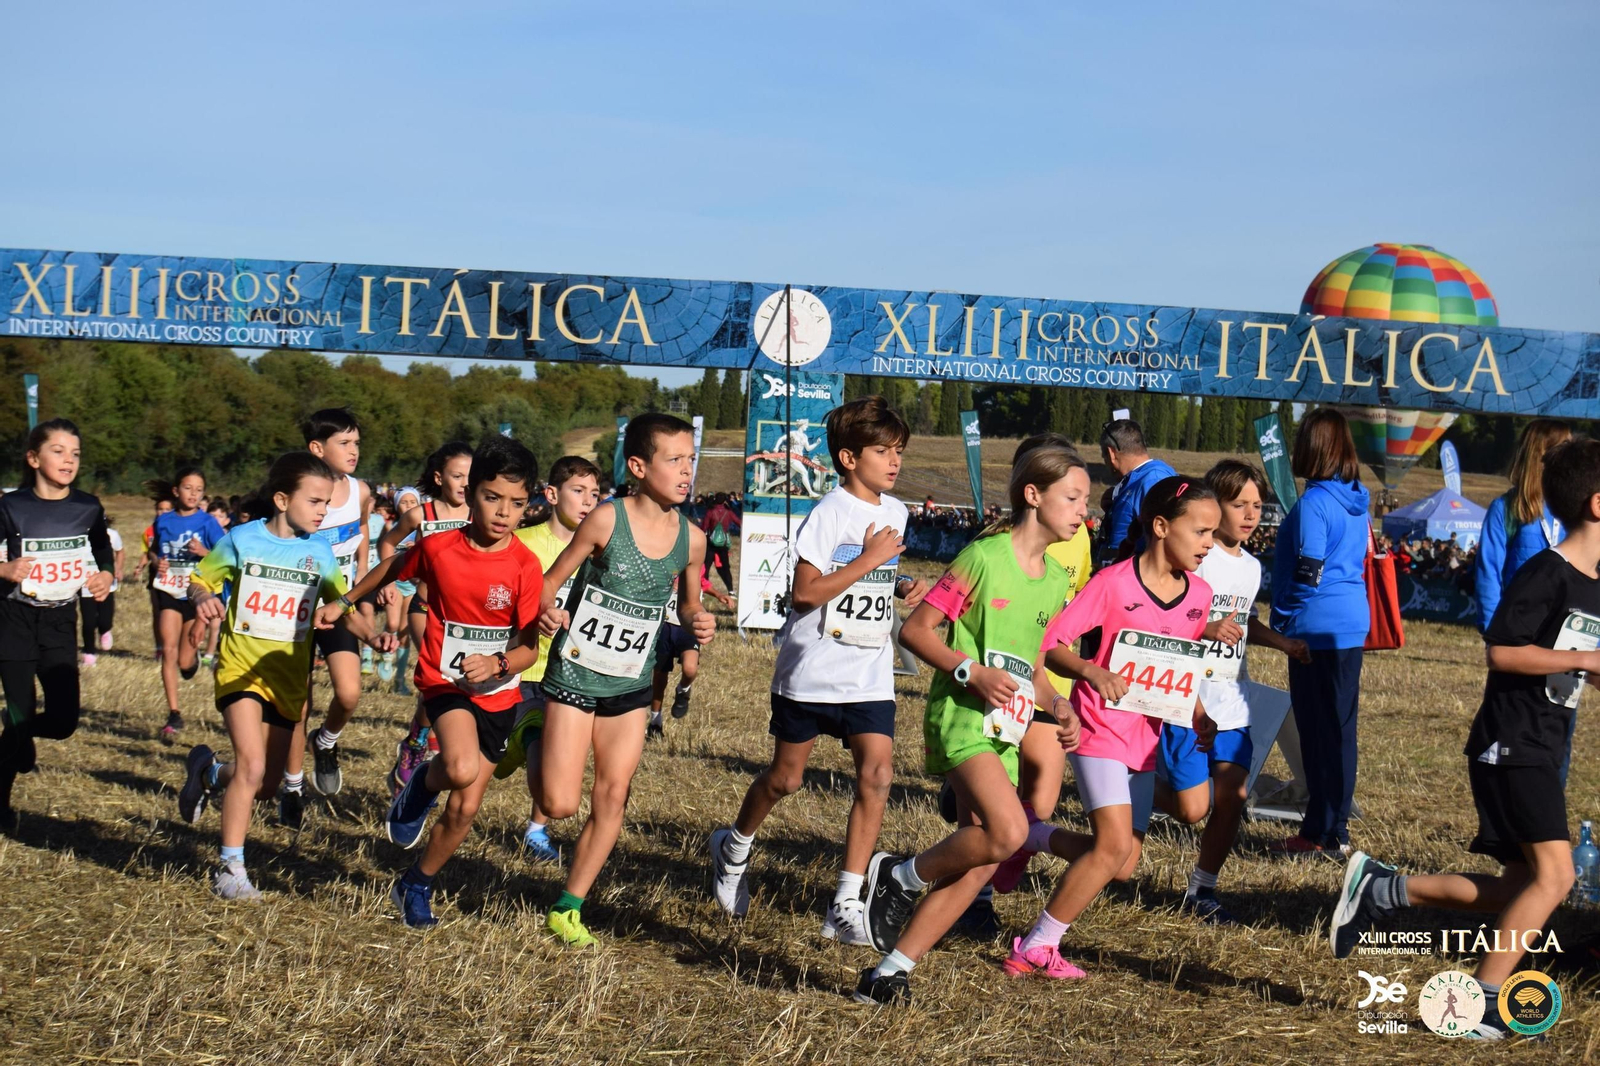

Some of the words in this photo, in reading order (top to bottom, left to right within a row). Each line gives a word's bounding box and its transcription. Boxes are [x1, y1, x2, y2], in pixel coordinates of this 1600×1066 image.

[11, 262, 171, 320] XLIII
[175, 270, 301, 305] CROSS
[174, 305, 345, 327] INTERNACIONAL
[357, 268, 659, 346] ITÁLICA
[9, 318, 160, 341] INTERNATIONAL
[164, 325, 222, 342] CROSS
[225, 327, 314, 346] COUNTRY
[873, 301, 1032, 360] XLIII
[1037, 312, 1160, 349] CROSS
[1036, 345, 1203, 371] INTERNACIONAL
[1214, 315, 1511, 396] ITÁLICA
[872, 357, 1018, 380] INTERNATIONAL
[1025, 366, 1082, 384] CROSS
[1085, 369, 1173, 389] COUNTRY
[797, 389, 831, 399] Sevilla
[29, 559, 83, 584] 4355
[265, 567, 302, 582] ITÁLICA
[244, 590, 310, 623] 4446
[607, 598, 646, 618] ITÁLICA
[836, 593, 892, 622] 4296
[469, 627, 511, 640] ITÁLICA
[578, 617, 650, 655] 4154
[1116, 661, 1194, 698] 4444
